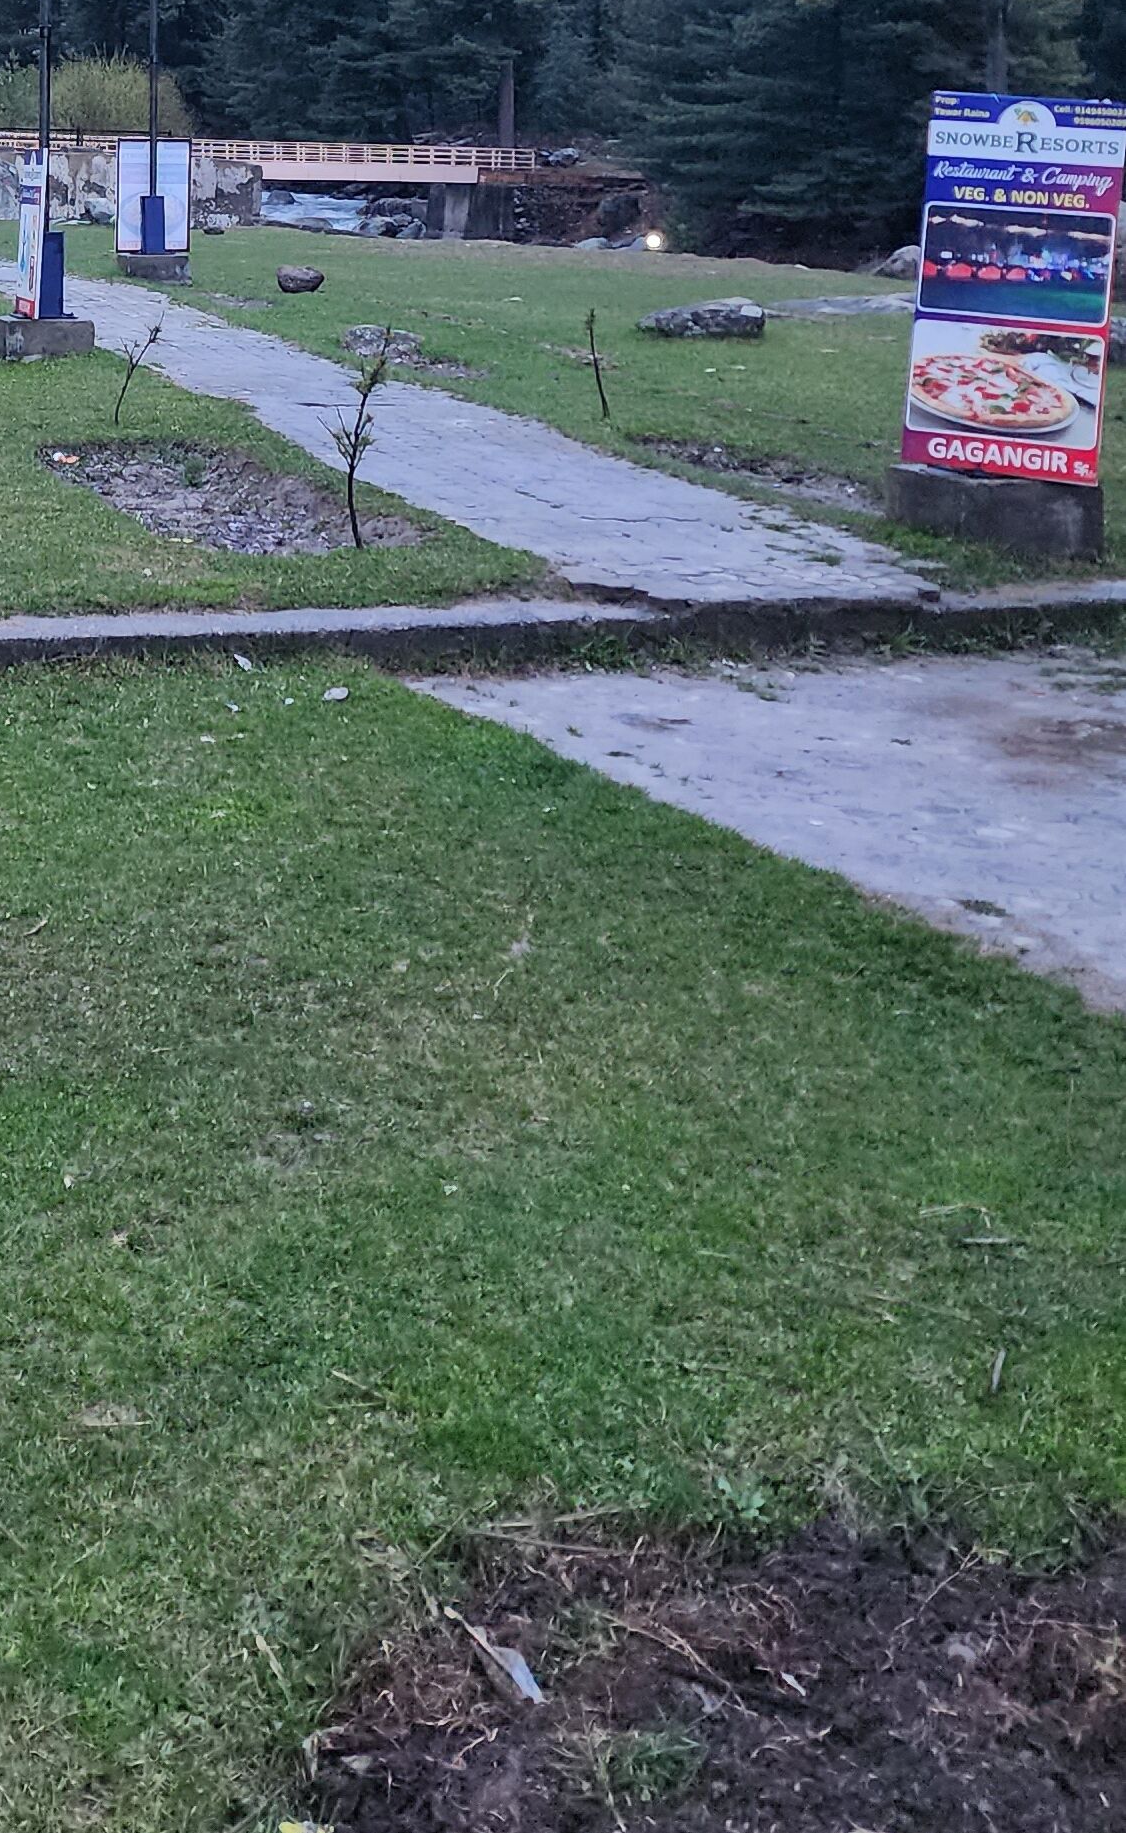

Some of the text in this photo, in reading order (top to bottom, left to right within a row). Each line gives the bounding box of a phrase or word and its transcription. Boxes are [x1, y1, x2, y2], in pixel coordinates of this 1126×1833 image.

[934, 160, 1114, 197] Restaurant & Camping
[953, 185, 1090, 209] VEG. & NON VEG.
[928, 437, 1068, 474] GAGANGIR
